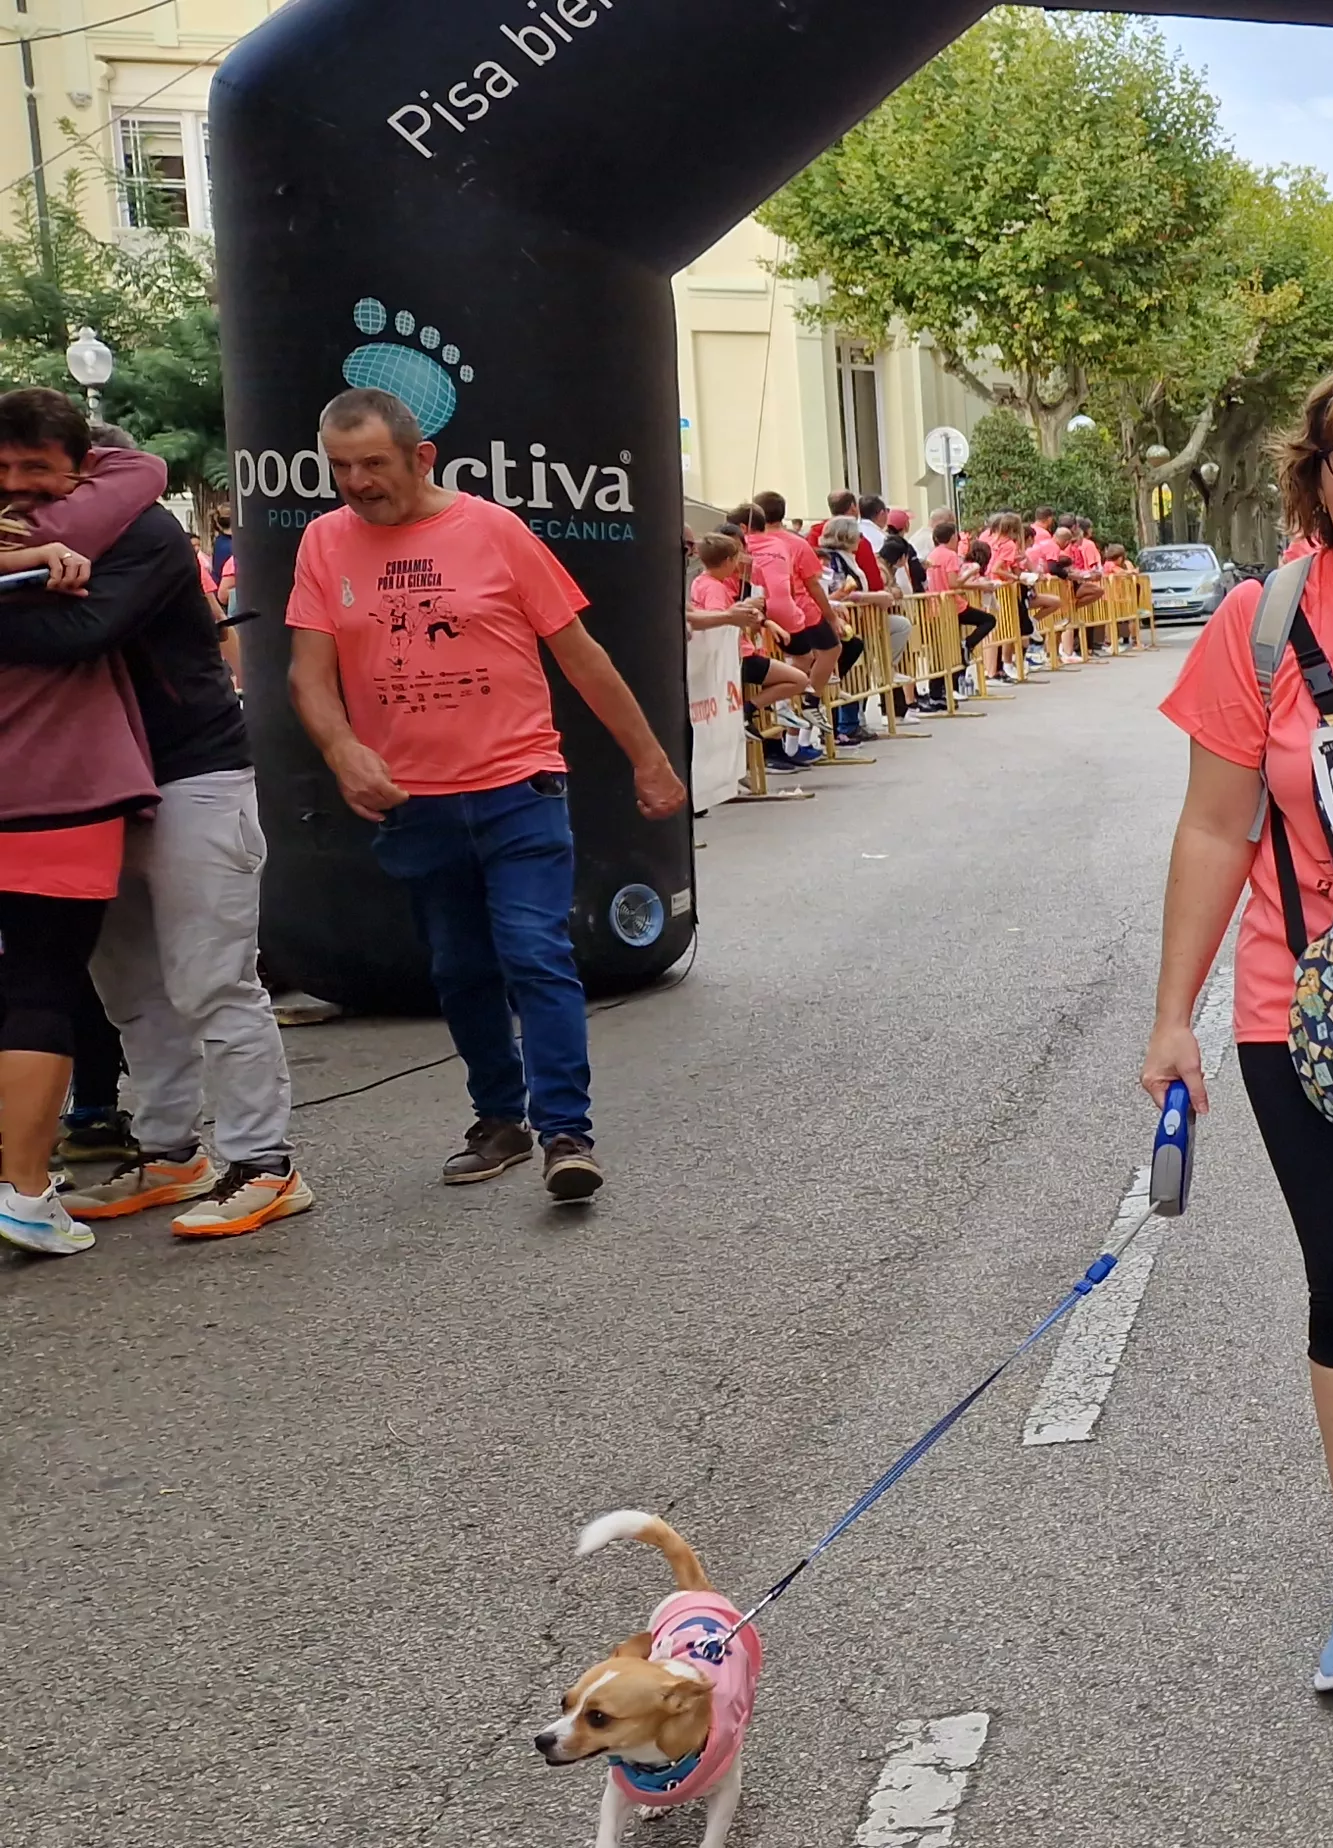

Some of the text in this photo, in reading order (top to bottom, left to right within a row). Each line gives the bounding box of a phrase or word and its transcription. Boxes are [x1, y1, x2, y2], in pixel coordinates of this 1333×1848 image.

[387, 60, 519, 158] Pisa
[529, 514, 634, 541] ECÁNICA
[385, 559, 433, 575] CORRAMOS
[378, 577, 394, 591] POR
[396, 575, 405, 589] LA
[408, 573, 442, 589] CIENCIA
